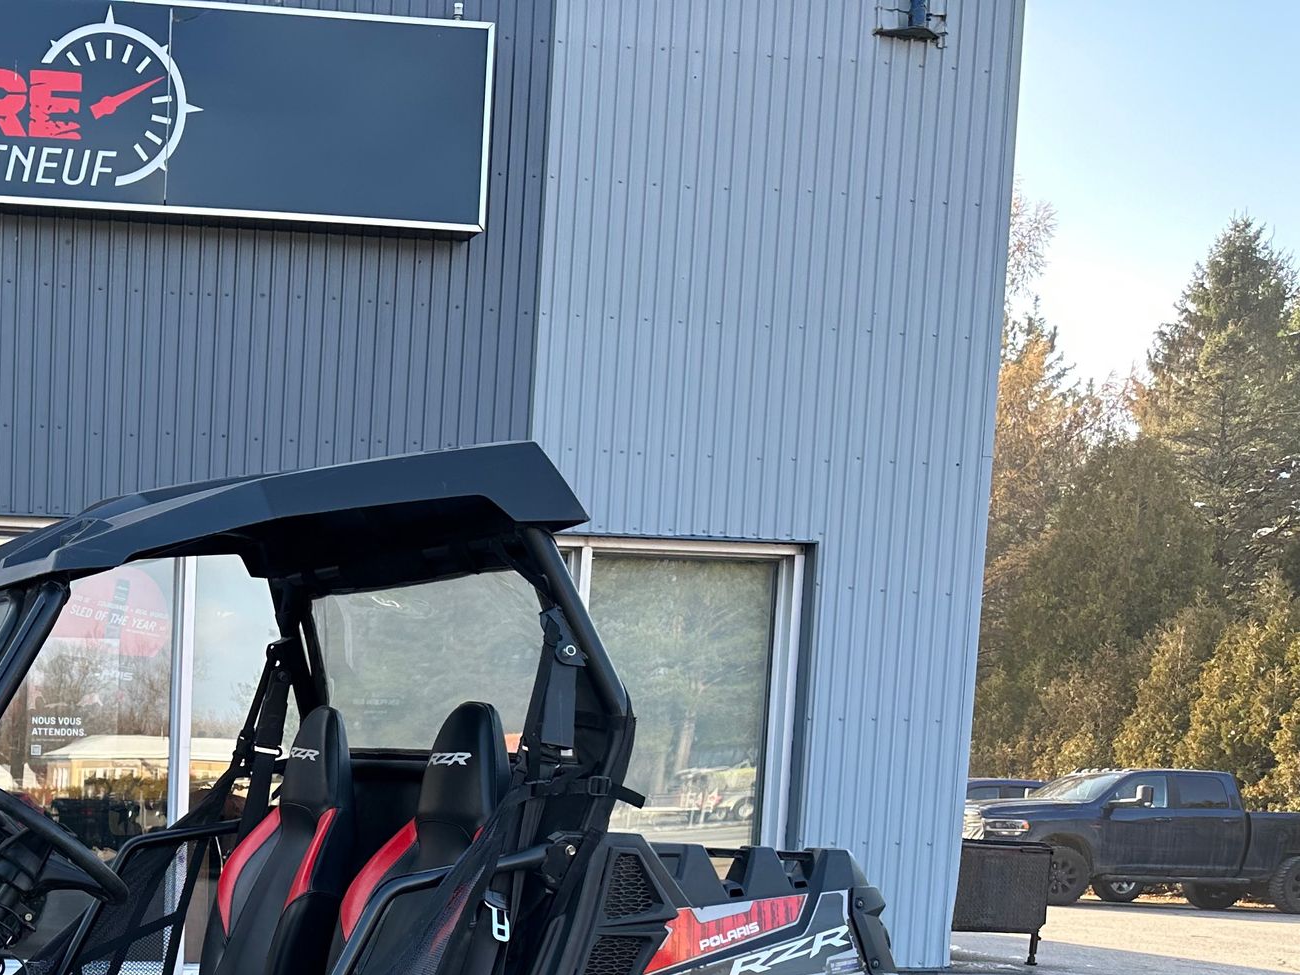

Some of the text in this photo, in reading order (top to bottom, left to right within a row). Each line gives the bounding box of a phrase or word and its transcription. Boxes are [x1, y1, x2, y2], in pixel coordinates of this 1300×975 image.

[70, 604, 93, 618] SLED
[95, 610, 108, 621] OF
[109, 613, 128, 626] THE
[132, 617, 157, 631] YEAR
[31, 716, 82, 726] NOUS VOUS
[31, 727, 88, 737] ATTENDONS.
[427, 752, 472, 767] RZR
[699, 921, 760, 951] POLARIS
